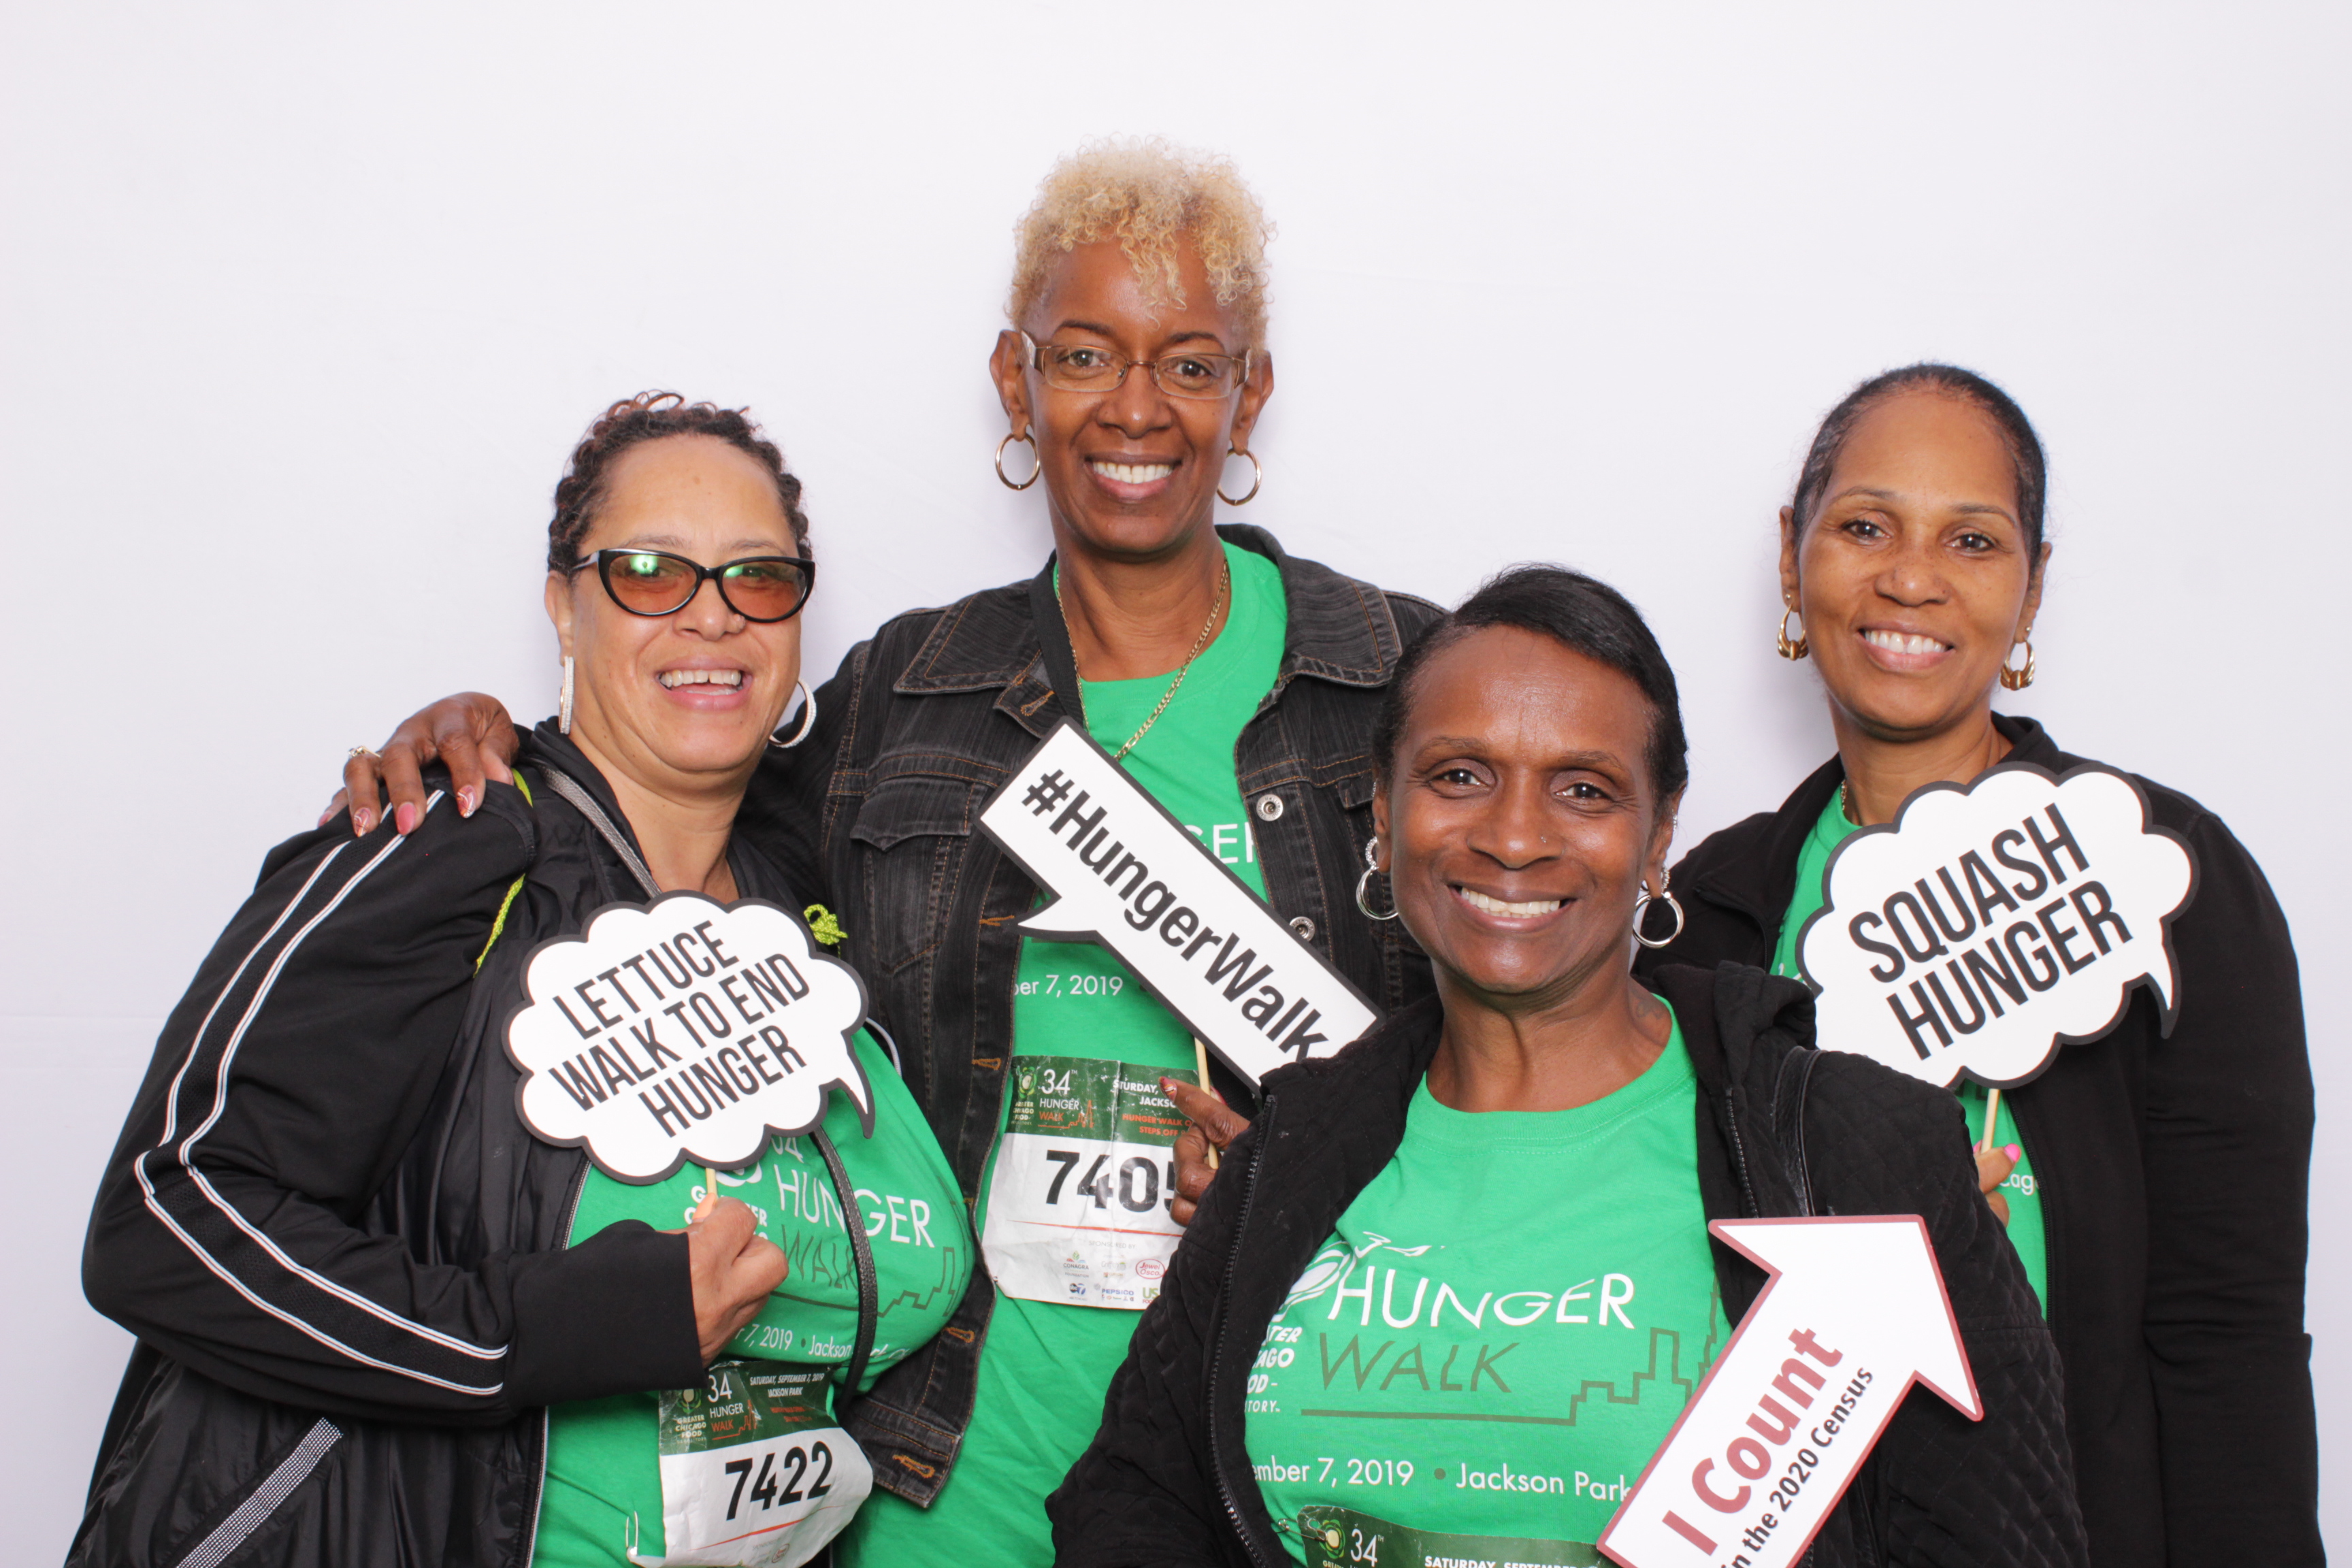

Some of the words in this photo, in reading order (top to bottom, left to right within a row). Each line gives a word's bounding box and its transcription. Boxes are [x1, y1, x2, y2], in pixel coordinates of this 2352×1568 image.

[1848, 802, 2090, 983] SQUASH
[1022, 769, 1328, 1062] #HungerWalk
[552, 920, 739, 1039] LETTUCE
[1045, 975, 1062, 998] 7,
[1069, 975, 1123, 996] 2019
[1886, 881, 2133, 1060] HUNGER
[548, 1017, 683, 1111] WALK
[662, 992, 732, 1049] TO
[718, 953, 810, 1025] END
[638, 1026, 807, 1138] HUNGER
[1039, 1098, 1079, 1110] HUNGER
[1039, 1111, 1064, 1121] WALK
[1122, 1114, 1157, 1124] HUNGER
[1158, 1118, 1183, 1126] WALK
[1139, 1126, 1161, 1135] STEPS
[774, 1164, 934, 1247] HUNGER
[1328, 1266, 1635, 1329] HUNGER
[760, 1326, 793, 1350] 2019
[808, 1335, 852, 1358] Jackson
[1319, 1332, 1520, 1393] WALK
[708, 1372, 732, 1403] 34
[777, 1373, 807, 1384] SEPTEMBER
[768, 1388, 789, 1398] JACKSON
[789, 1386, 804, 1396] PARK
[675, 1422, 707, 1432] CHICAGO
[676, 1414, 705, 1424] GREATER
[709, 1403, 745, 1418] HUNGER
[711, 1420, 734, 1432] WALK
[681, 1430, 702, 1438] FOOD
[1662, 1509, 1718, 1556] I
[1692, 1328, 1843, 1514] Count
[1742, 1513, 1778, 1552] the
[1769, 1448, 1819, 1512] 2020
[1810, 1367, 1873, 1448] Census
[725, 1441, 833, 1521] 7422
[1318, 1457, 1337, 1488] 7,
[1348, 1458, 1414, 1486] 2019
[1456, 1463, 1564, 1494] Jackson
[1575, 1471, 1631, 1502] Park
